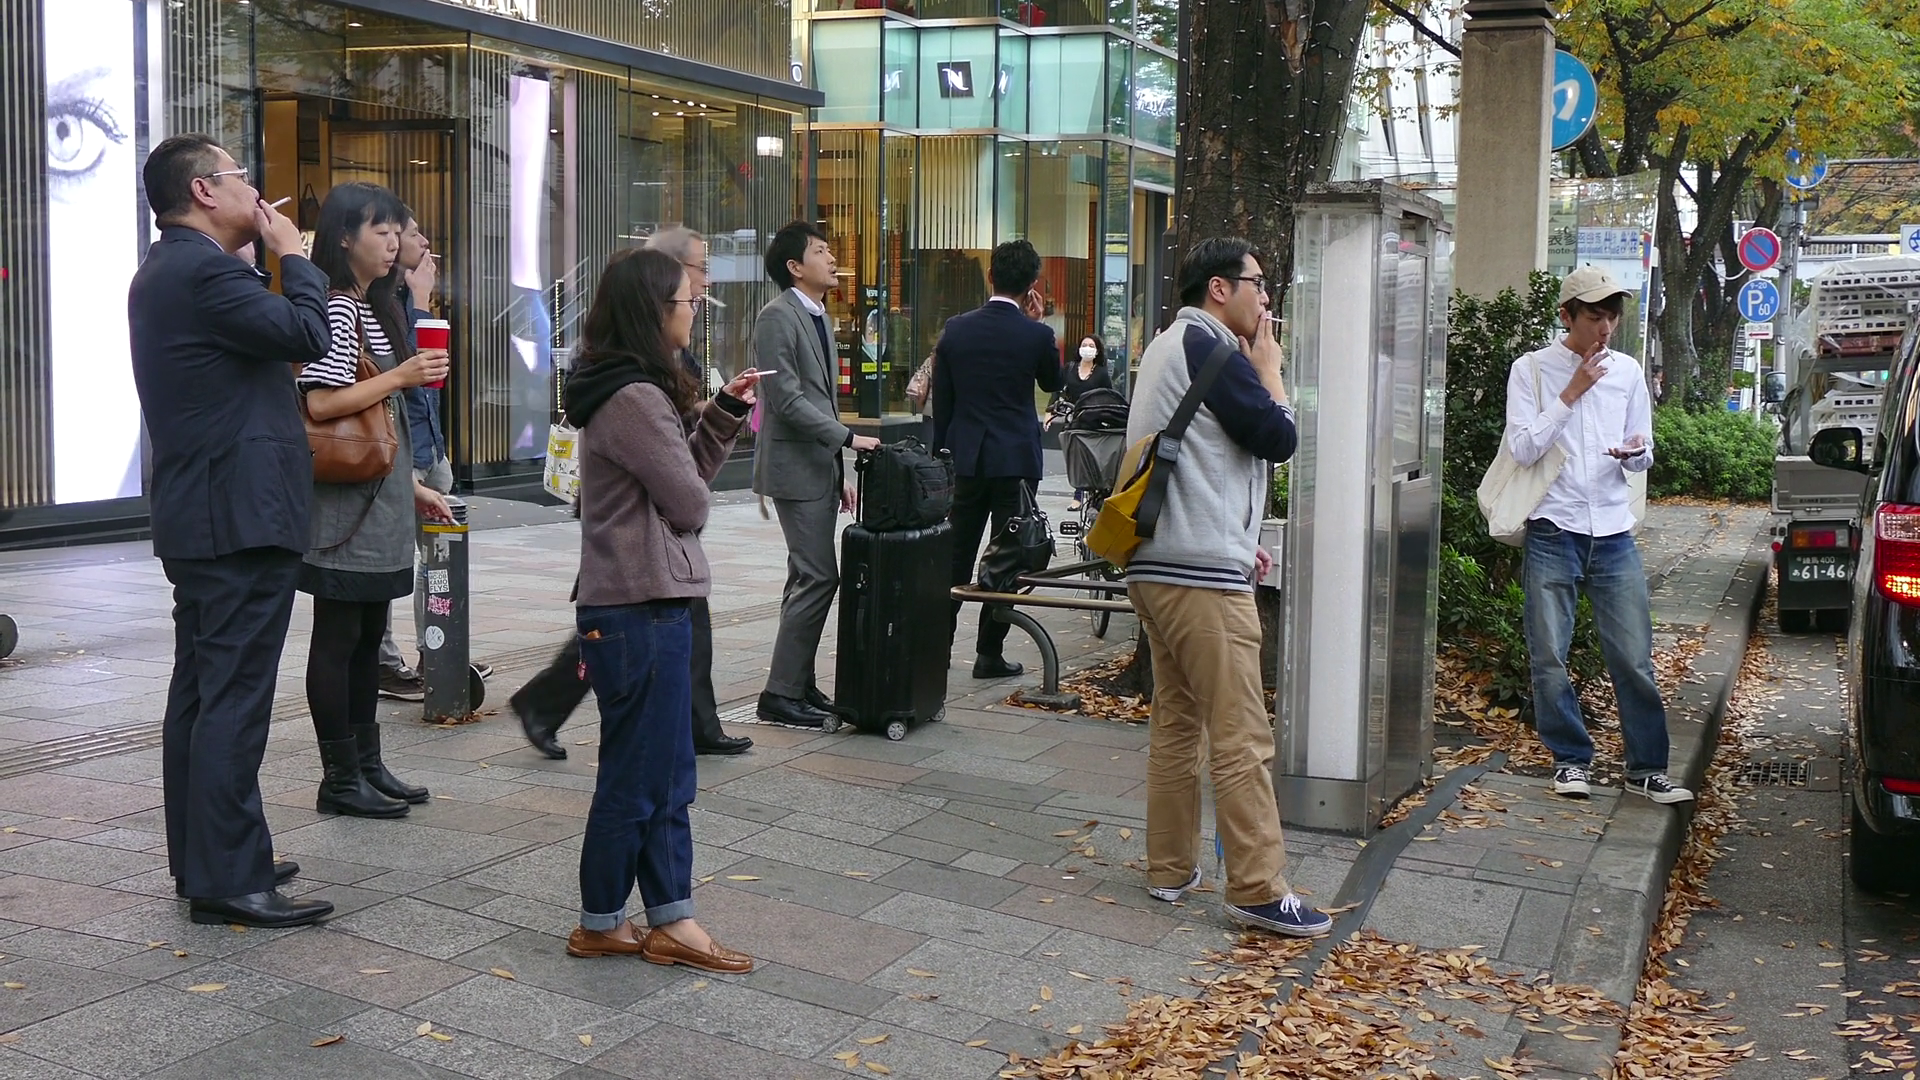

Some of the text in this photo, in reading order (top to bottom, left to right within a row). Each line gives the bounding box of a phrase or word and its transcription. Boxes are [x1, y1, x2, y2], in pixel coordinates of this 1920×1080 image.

[942, 68, 969, 91] N
[1748, 290, 1763, 317] P
[1820, 556, 1835, 564] 400
[1801, 564, 1846, 580] 61-46
